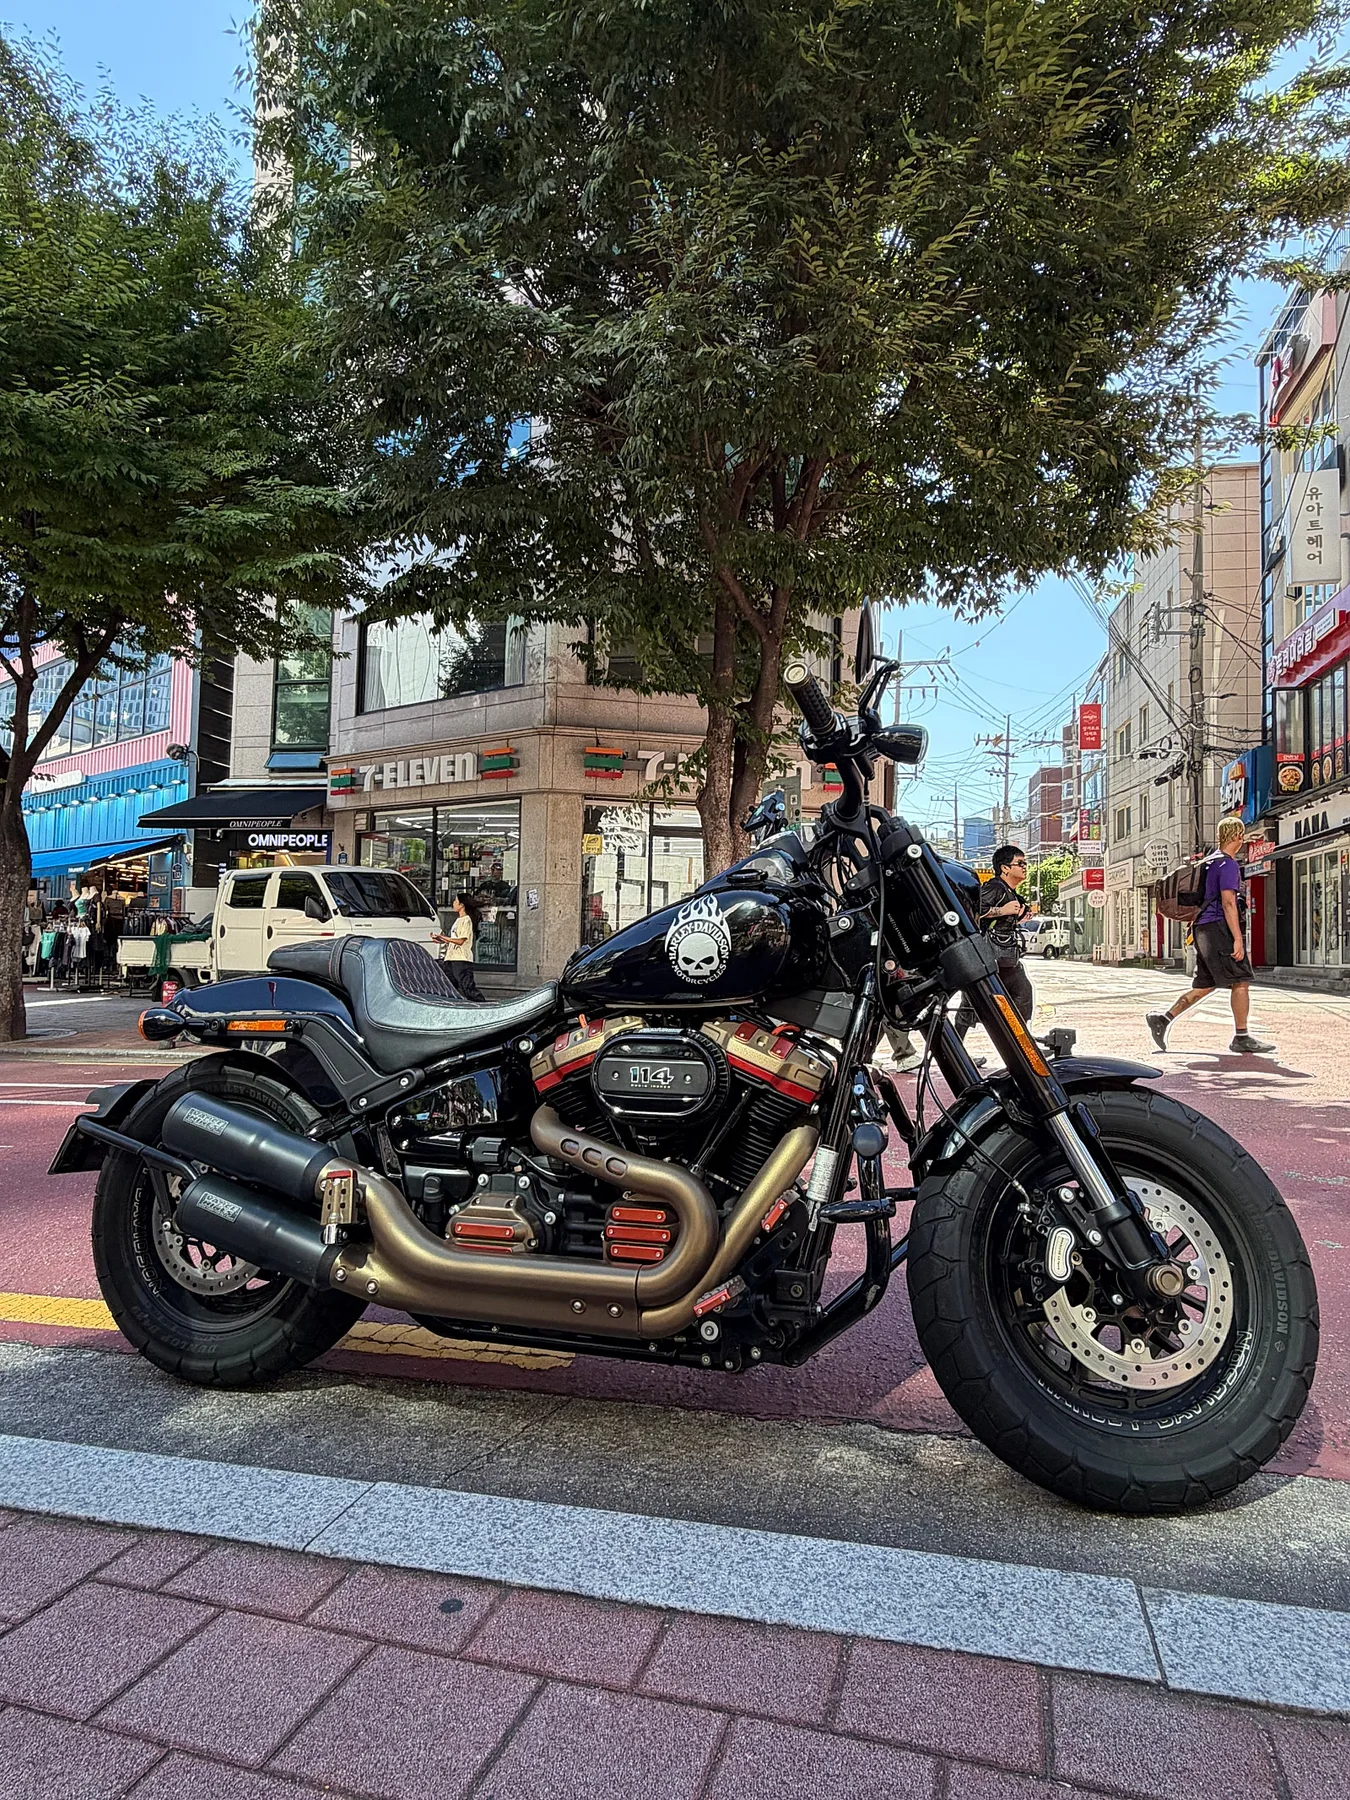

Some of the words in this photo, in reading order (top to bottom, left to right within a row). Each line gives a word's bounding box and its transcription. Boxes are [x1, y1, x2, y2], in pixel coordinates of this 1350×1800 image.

[1305, 486, 1324, 565] 유아트헤어
[229, 820, 282, 829] OMNIPEOPLE
[248, 833, 328, 847] OMNIPEOPLE
[669, 920, 729, 960] HARLEY-DAVIDSON
[671, 962, 727, 985] MOTORCYCLES
[629, 1066, 675, 1085] 114
